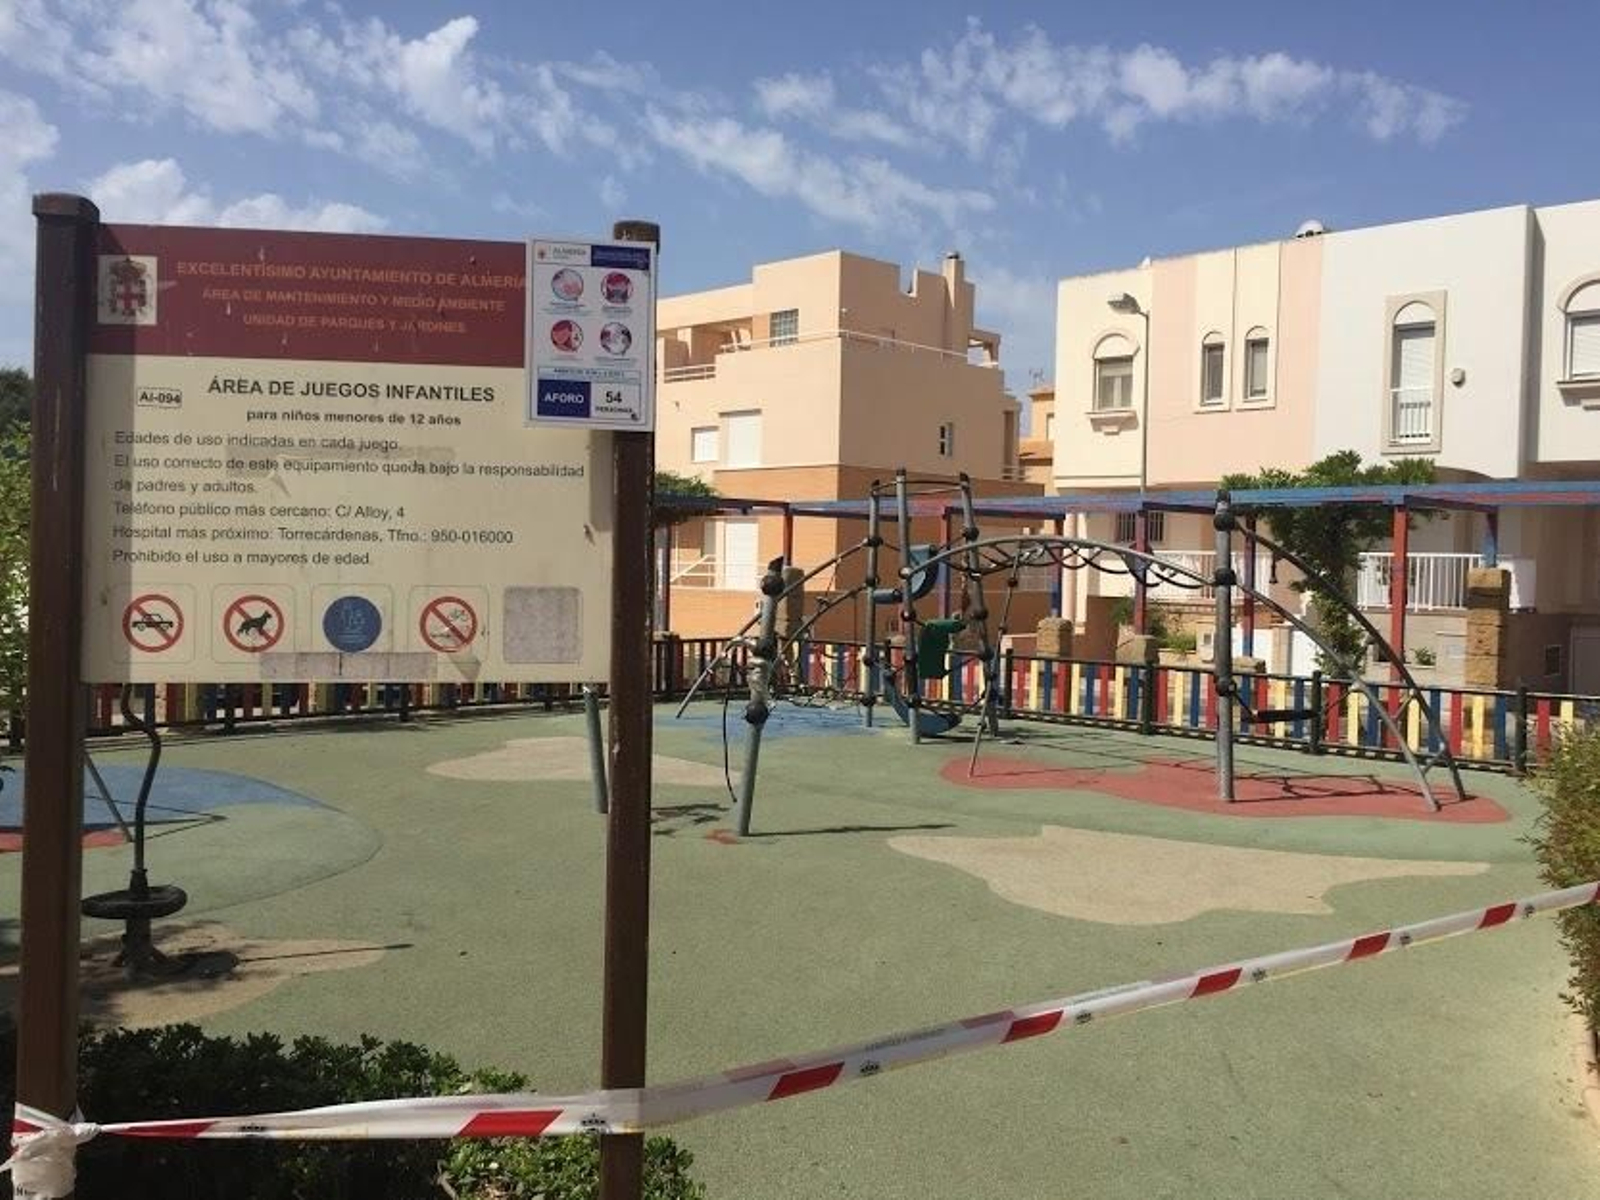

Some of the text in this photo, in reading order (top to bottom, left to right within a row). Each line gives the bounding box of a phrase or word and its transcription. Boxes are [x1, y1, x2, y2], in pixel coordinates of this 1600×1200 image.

[308, 266, 431, 284] AYUNTAMIENTO
[436, 273, 457, 286] DE
[202, 285, 506, 312] ÁREA DE MANTENIMIENTO Y MEDIO AMBIENTE
[243, 314, 294, 327] UNIDAD
[298, 315, 318, 328] DE
[322, 318, 384, 331] PARQUES
[390, 321, 397, 331] Y
[208, 376, 495, 402] ÁREA DE JUEGOS INFANTILES
[544, 392, 585, 404] AFORO
[605, 390, 623, 404] 54
[246, 409, 462, 426] para niños menores de 12 años
[115, 431, 170, 445] Edades
[173, 431, 193, 446] de
[196, 436, 223, 446] uso
[227, 431, 295, 448] indicadas
[299, 438, 317, 448] en
[320, 436, 356, 450] cada
[114, 454, 585, 478] El uso correcto de este equipamiento queda bajo la responsabilidad
[114, 477, 132, 491] de
[136, 478, 187, 495] padres
[190, 483, 198, 495] y
[114, 501, 176, 516] Teléfono
[179, 500, 232, 518] público
[234, 502, 266, 518] más
[269, 505, 332, 519] cercano:
[354, 504, 392, 523] Alloy,
[396, 506, 405, 518] 4
[112, 525, 172, 542] Hospital
[175, 524, 208, 539] más
[211, 525, 274, 542] próximo:
[430, 529, 514, 544] 950-016000
[112, 549, 183, 564] Prohibido
[185, 549, 199, 564] el
[202, 553, 229, 565] uso
[233, 554, 243, 565] a
[246, 553, 308, 569] mayores
[311, 550, 331, 566] de
